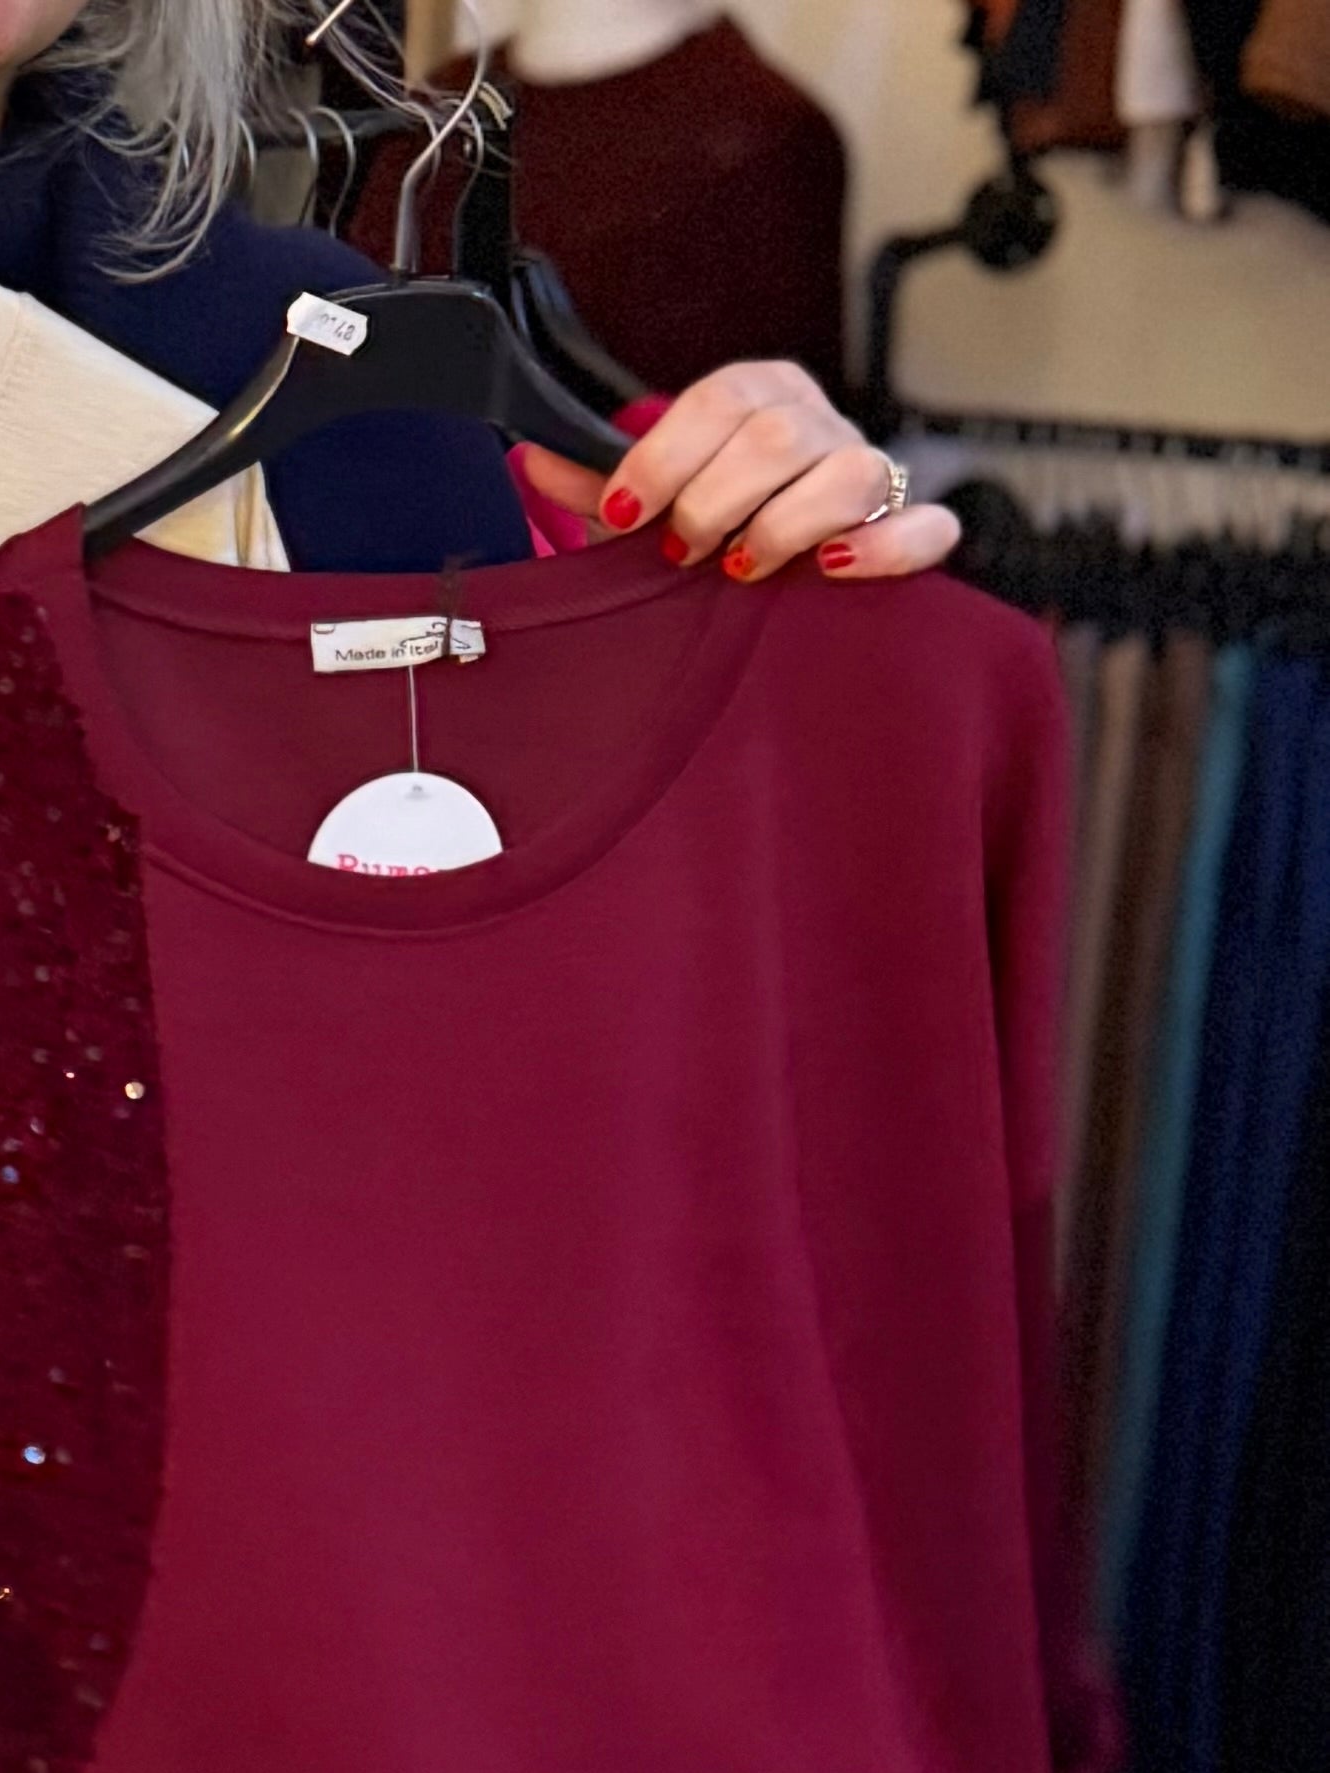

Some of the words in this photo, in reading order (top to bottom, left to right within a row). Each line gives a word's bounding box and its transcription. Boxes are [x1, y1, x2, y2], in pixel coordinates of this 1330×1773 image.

[335, 648, 385, 662] Made
[391, 647, 405, 658] in
[410, 641, 439, 656] Ital
